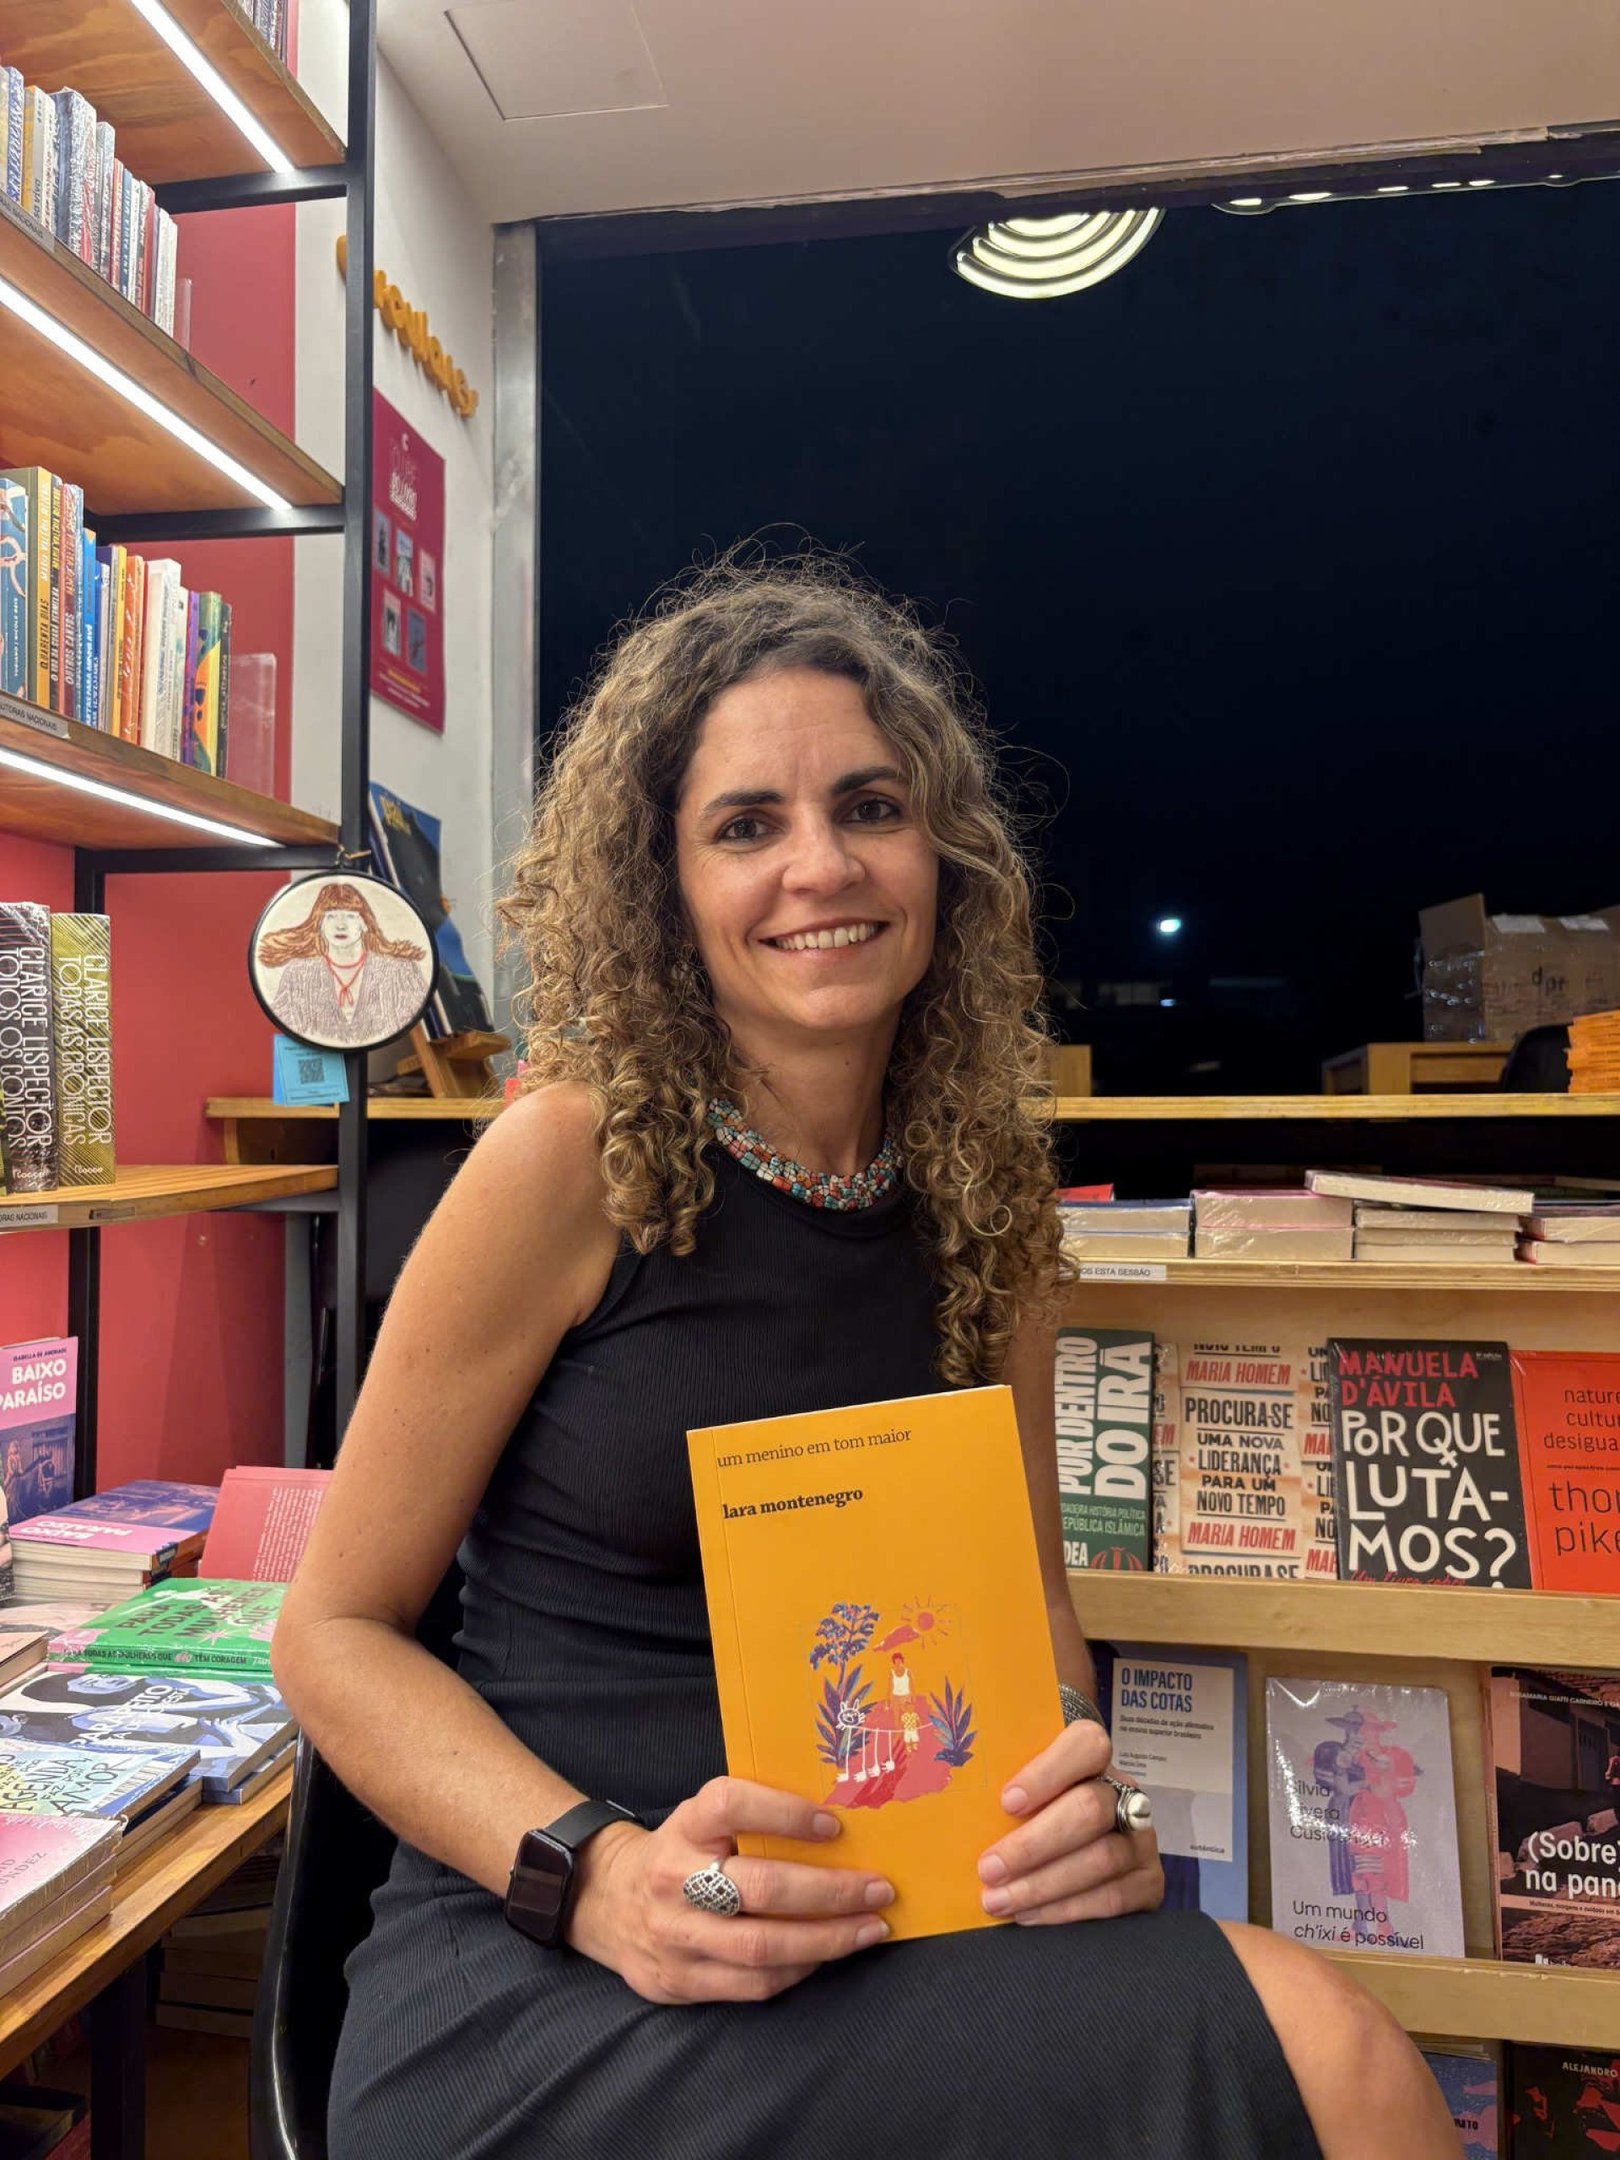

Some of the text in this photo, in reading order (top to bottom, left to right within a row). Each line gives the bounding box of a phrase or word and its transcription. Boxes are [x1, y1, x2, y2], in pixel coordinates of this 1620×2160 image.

[58, 956, 82, 1021] TODAS
[0, 948, 27, 1148] TODOS OS CONTOS
[19, 947, 52, 1146] CLARICE LISPECTOR
[61, 1025, 83, 1049] AS
[83, 955, 112, 1145] CLARICE LISPECTOR
[1094, 1267, 1116, 1276] ESTA
[12, 1358, 67, 1385] BAIXO
[1186, 1359, 1292, 1386] MARIA HOMEM
[1338, 1350, 1479, 1379] MANUELA
[1341, 1376, 1456, 1408] D'ÁVILA
[1055, 1336, 1098, 1496] POR DENTRO
[1185, 1396, 1295, 1430] PROCURA-SE
[717, 1428, 912, 1468] um menino em tom maior
[1197, 1432, 1285, 1451] UMA NOVA
[1415, 1411, 1506, 1466] QUE
[1094, 1428, 1149, 1500] DO
[1198, 1449, 1282, 1480] LIDERANÇA
[1201, 1475, 1277, 1492] PARA UM
[1346, 1460, 1509, 1522] LUTA-
[1549, 1481, 1620, 1514] tho
[723, 1488, 864, 1519] lara montenegro
[1197, 1490, 1286, 1517] NOVO TEMPO
[1187, 1521, 1297, 1550] MARIA HOMEM
[1348, 1523, 1516, 1588] MOS?
[116, 1603, 174, 1630] PARA
[138, 1603, 209, 1637] TODAS
[233, 1605, 279, 1626] QUE
[210, 1655, 248, 1665] CORAGEM
[1121, 1667, 1193, 1692] O IMPACTO
[1121, 1689, 1193, 1713] DAS COTAS
[1294, 1802, 1341, 1820] ivera
[1525, 1868, 1620, 1900] na pan
[1292, 1900, 1387, 1923] Um mundo
[1294, 1924, 1424, 1950] ch'ixi é possível
[1562, 2061, 1618, 2078] ALEJANDRO
